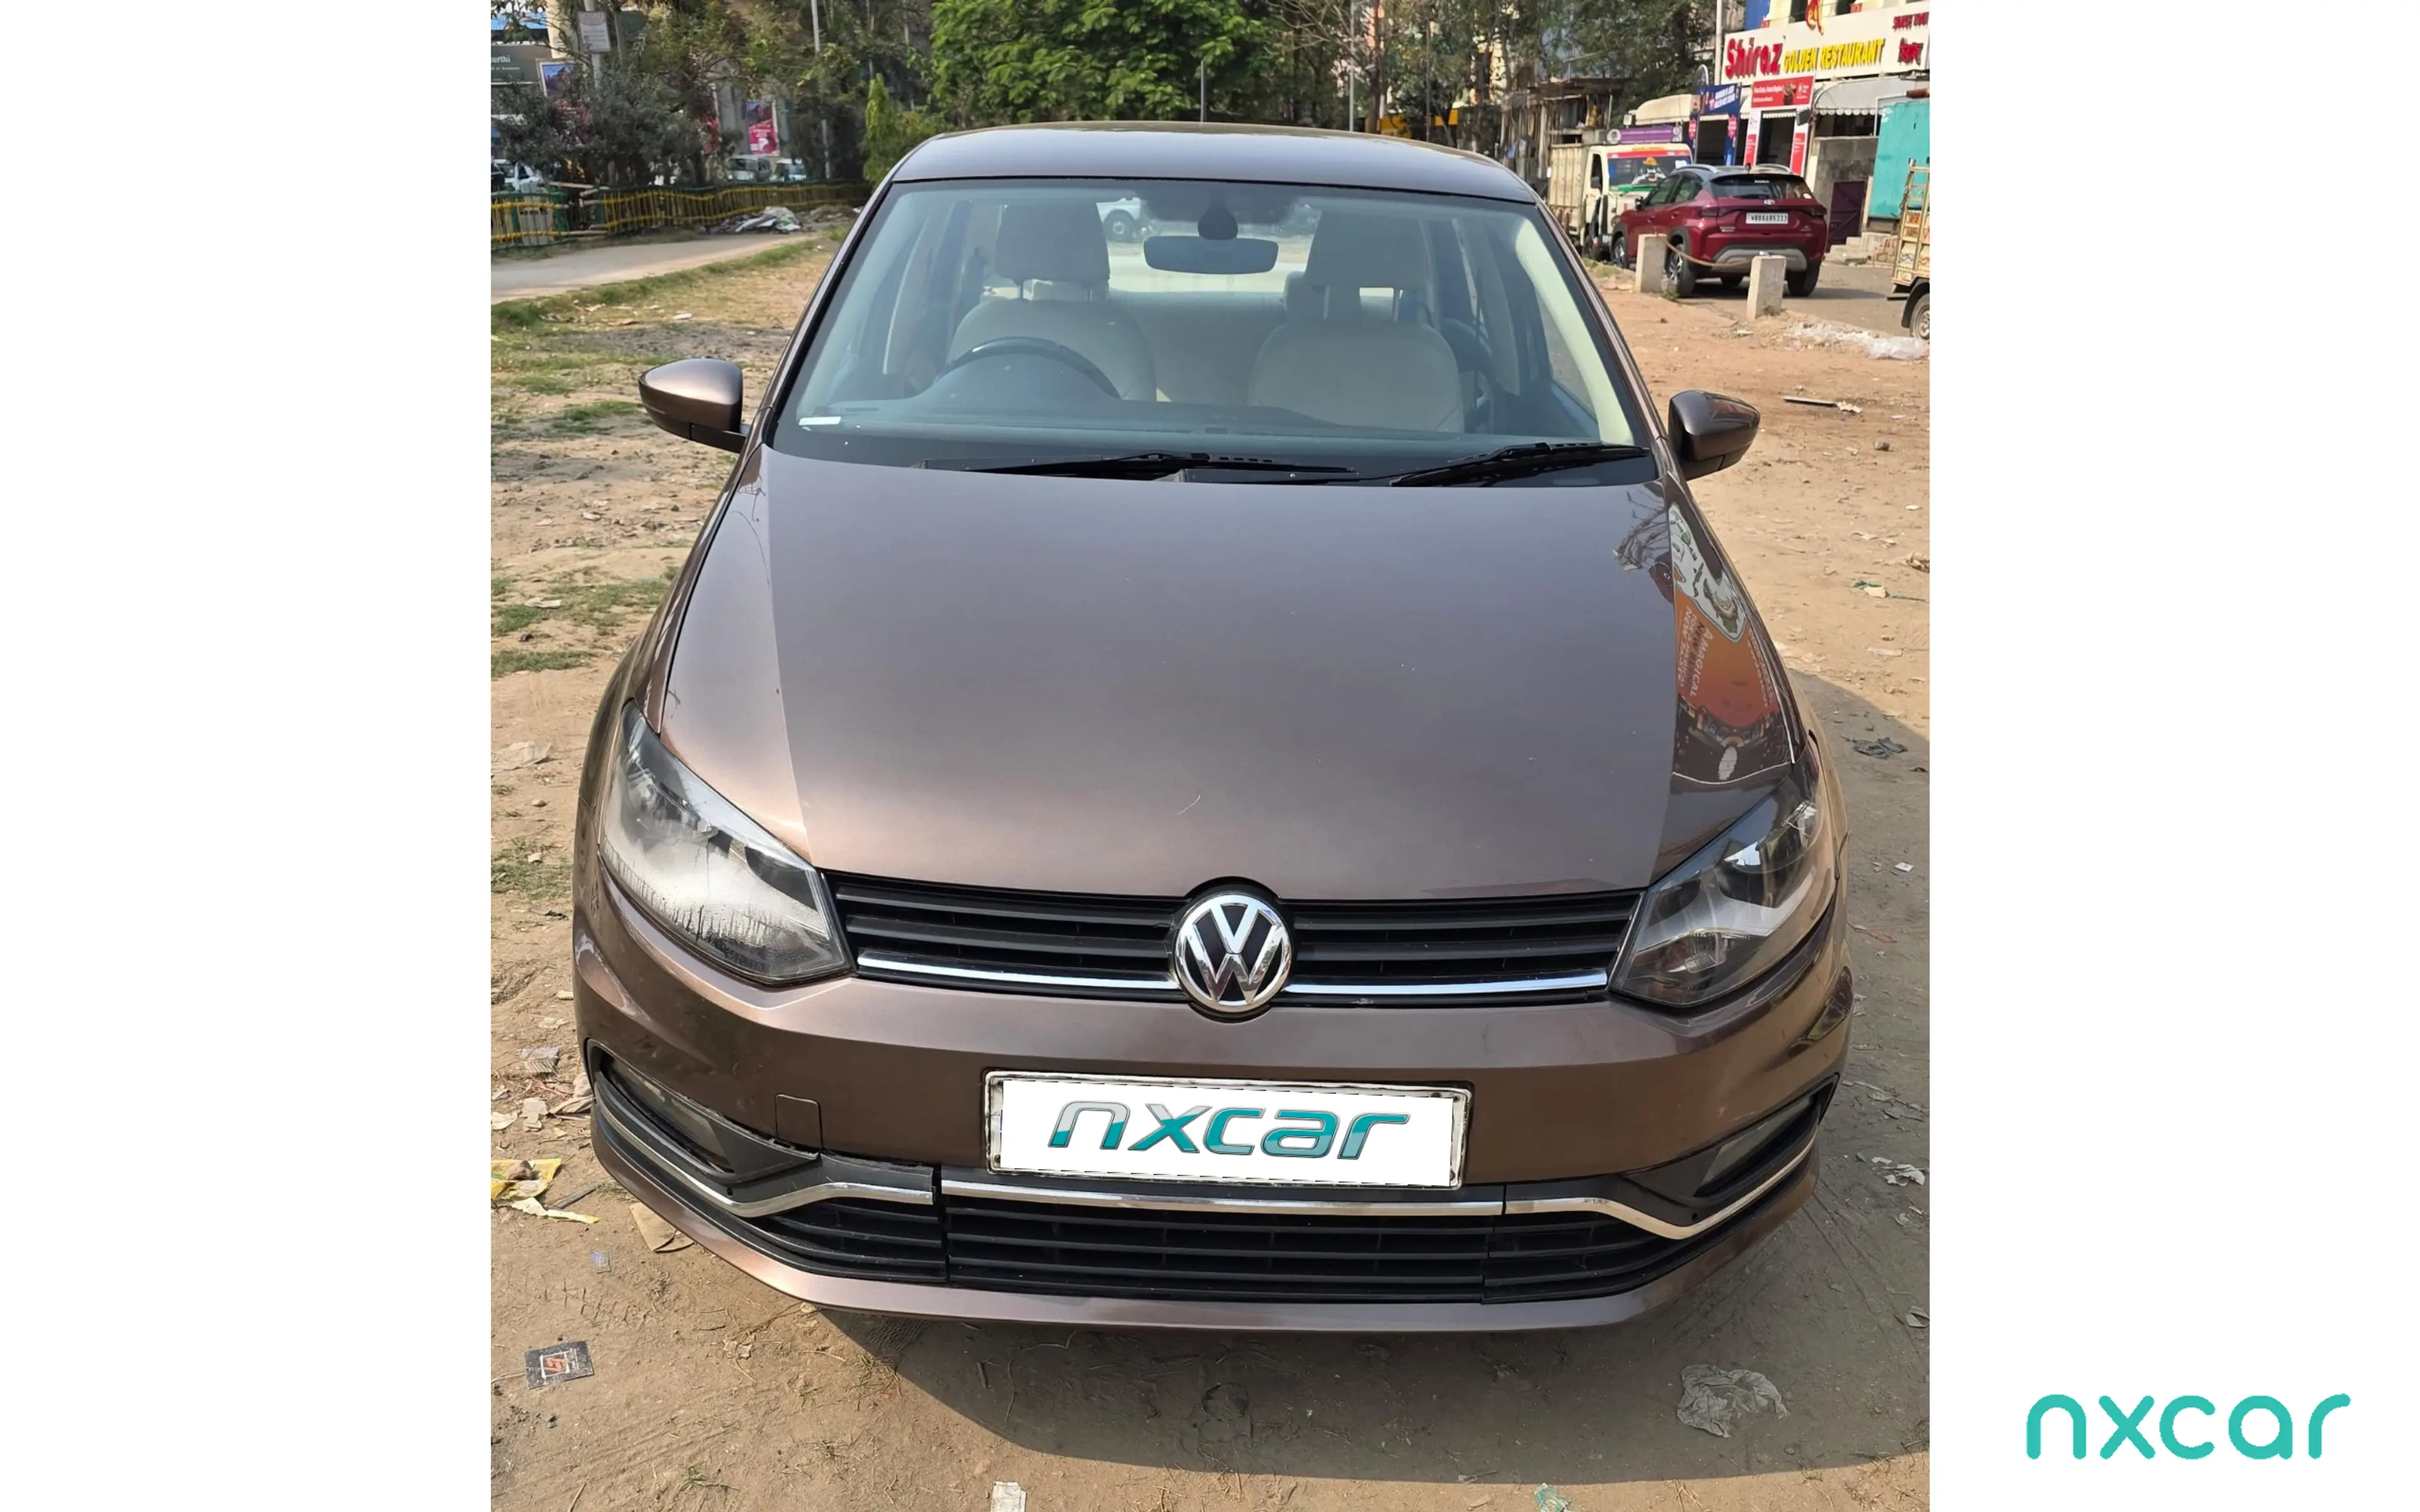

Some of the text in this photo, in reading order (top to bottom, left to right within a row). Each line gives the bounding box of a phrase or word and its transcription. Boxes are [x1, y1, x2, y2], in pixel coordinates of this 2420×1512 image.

[1725, 37, 1886, 79] Shiraz GOLDEN RESTAURANT
